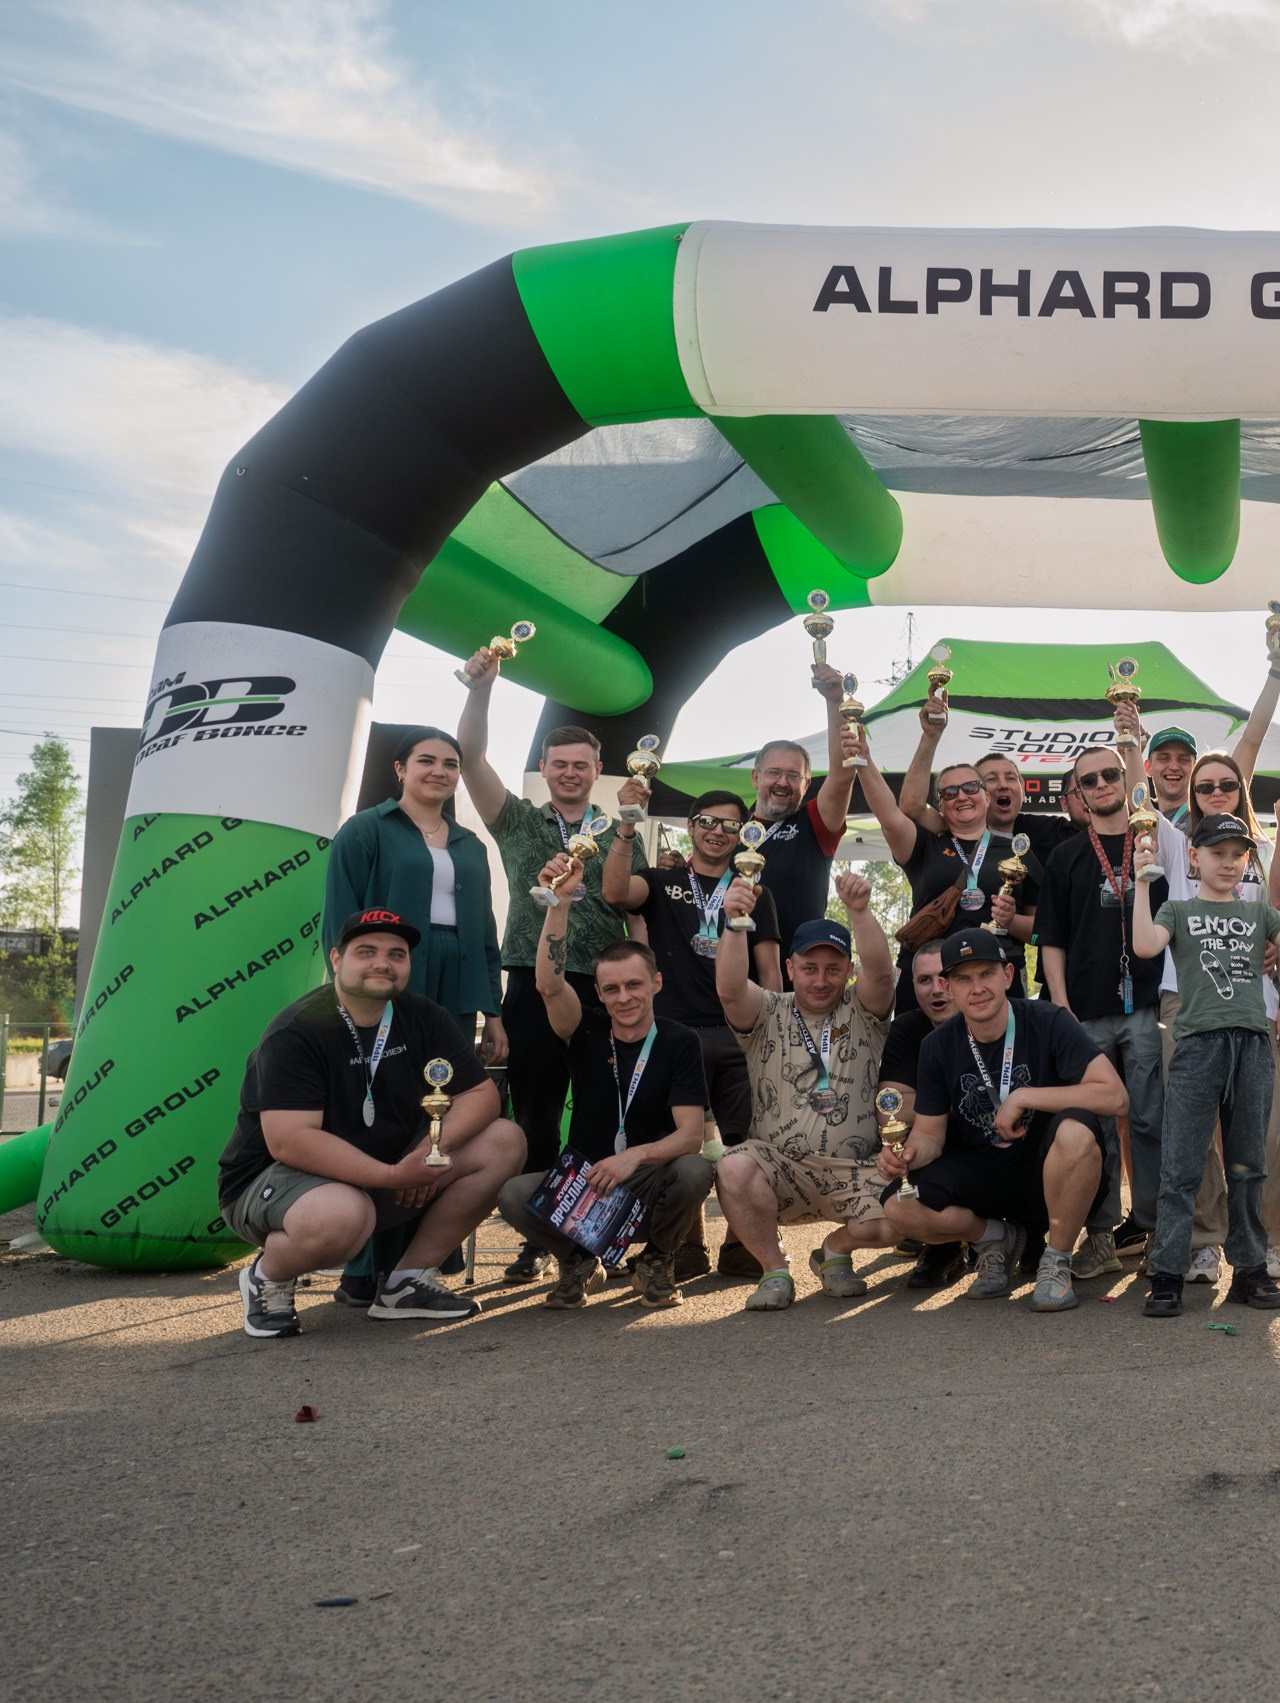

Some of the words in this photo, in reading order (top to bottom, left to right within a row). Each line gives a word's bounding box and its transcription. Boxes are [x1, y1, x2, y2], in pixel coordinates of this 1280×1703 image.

[813, 265, 1211, 319] ALPHARD
[969, 727, 1114, 743] STUDIO
[111, 831, 213, 926] ALPHARD
[192, 850, 311, 930] ALPHARD
[360, 910, 400, 924] KICX
[1188, 915, 1257, 937] ENJOY
[1200, 938, 1226, 950] THE
[1229, 938, 1254, 952] DAY
[77, 964, 134, 1037] GROUP
[175, 938, 294, 1023] ALPHARD
[373, 1038, 384, 1061] ПРИЗ
[968, 1035, 993, 1088] АВТОЗВУК
[1002, 1061, 1011, 1085] ПРИЗ
[55, 1059, 115, 1134] GROUP
[124, 1068, 221, 1138] GROUP
[100, 1156, 195, 1228] GROUP
[550, 1160, 593, 1228] ЯРОСЛАВЛЯ
[556, 1173, 575, 1201] КУБОК
